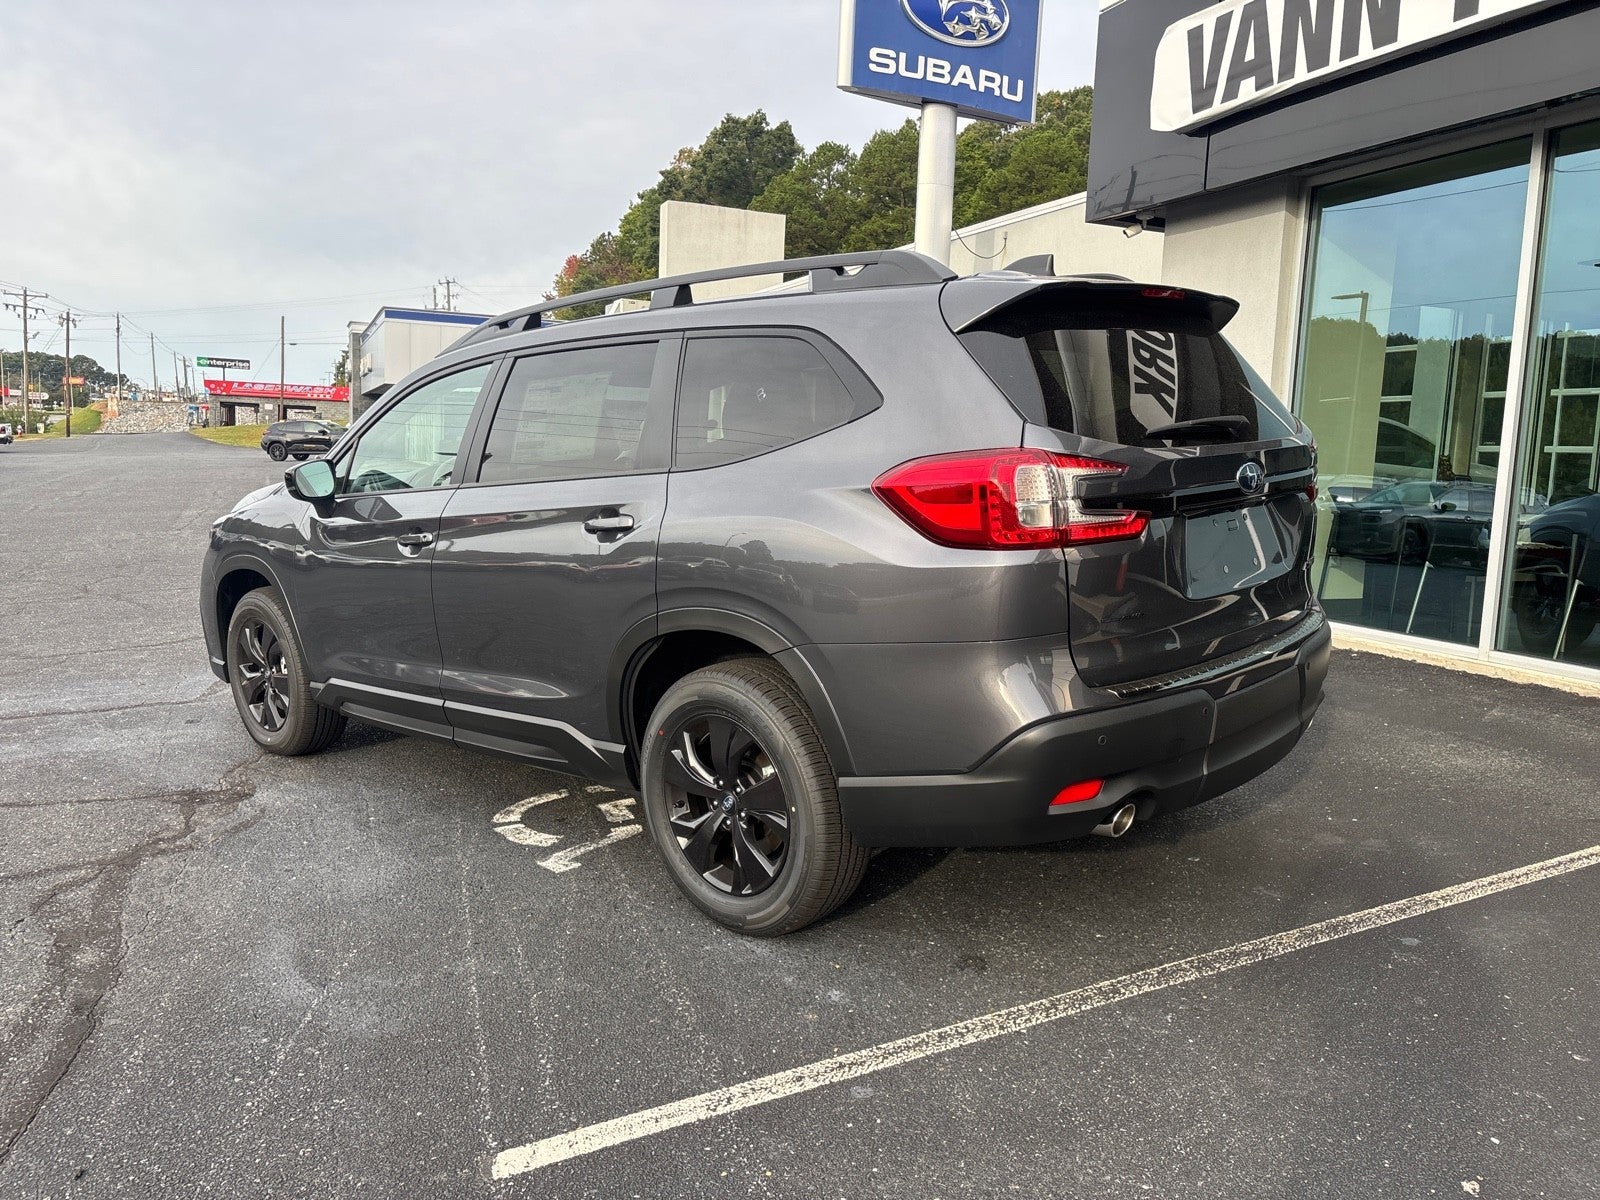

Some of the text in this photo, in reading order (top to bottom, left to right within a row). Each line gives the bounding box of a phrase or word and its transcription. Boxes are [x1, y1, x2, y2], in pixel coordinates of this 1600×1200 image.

[868, 47, 1024, 103] SUBARU
[1187, 0, 1401, 114] VANN
[199, 358, 250, 368] enterprise
